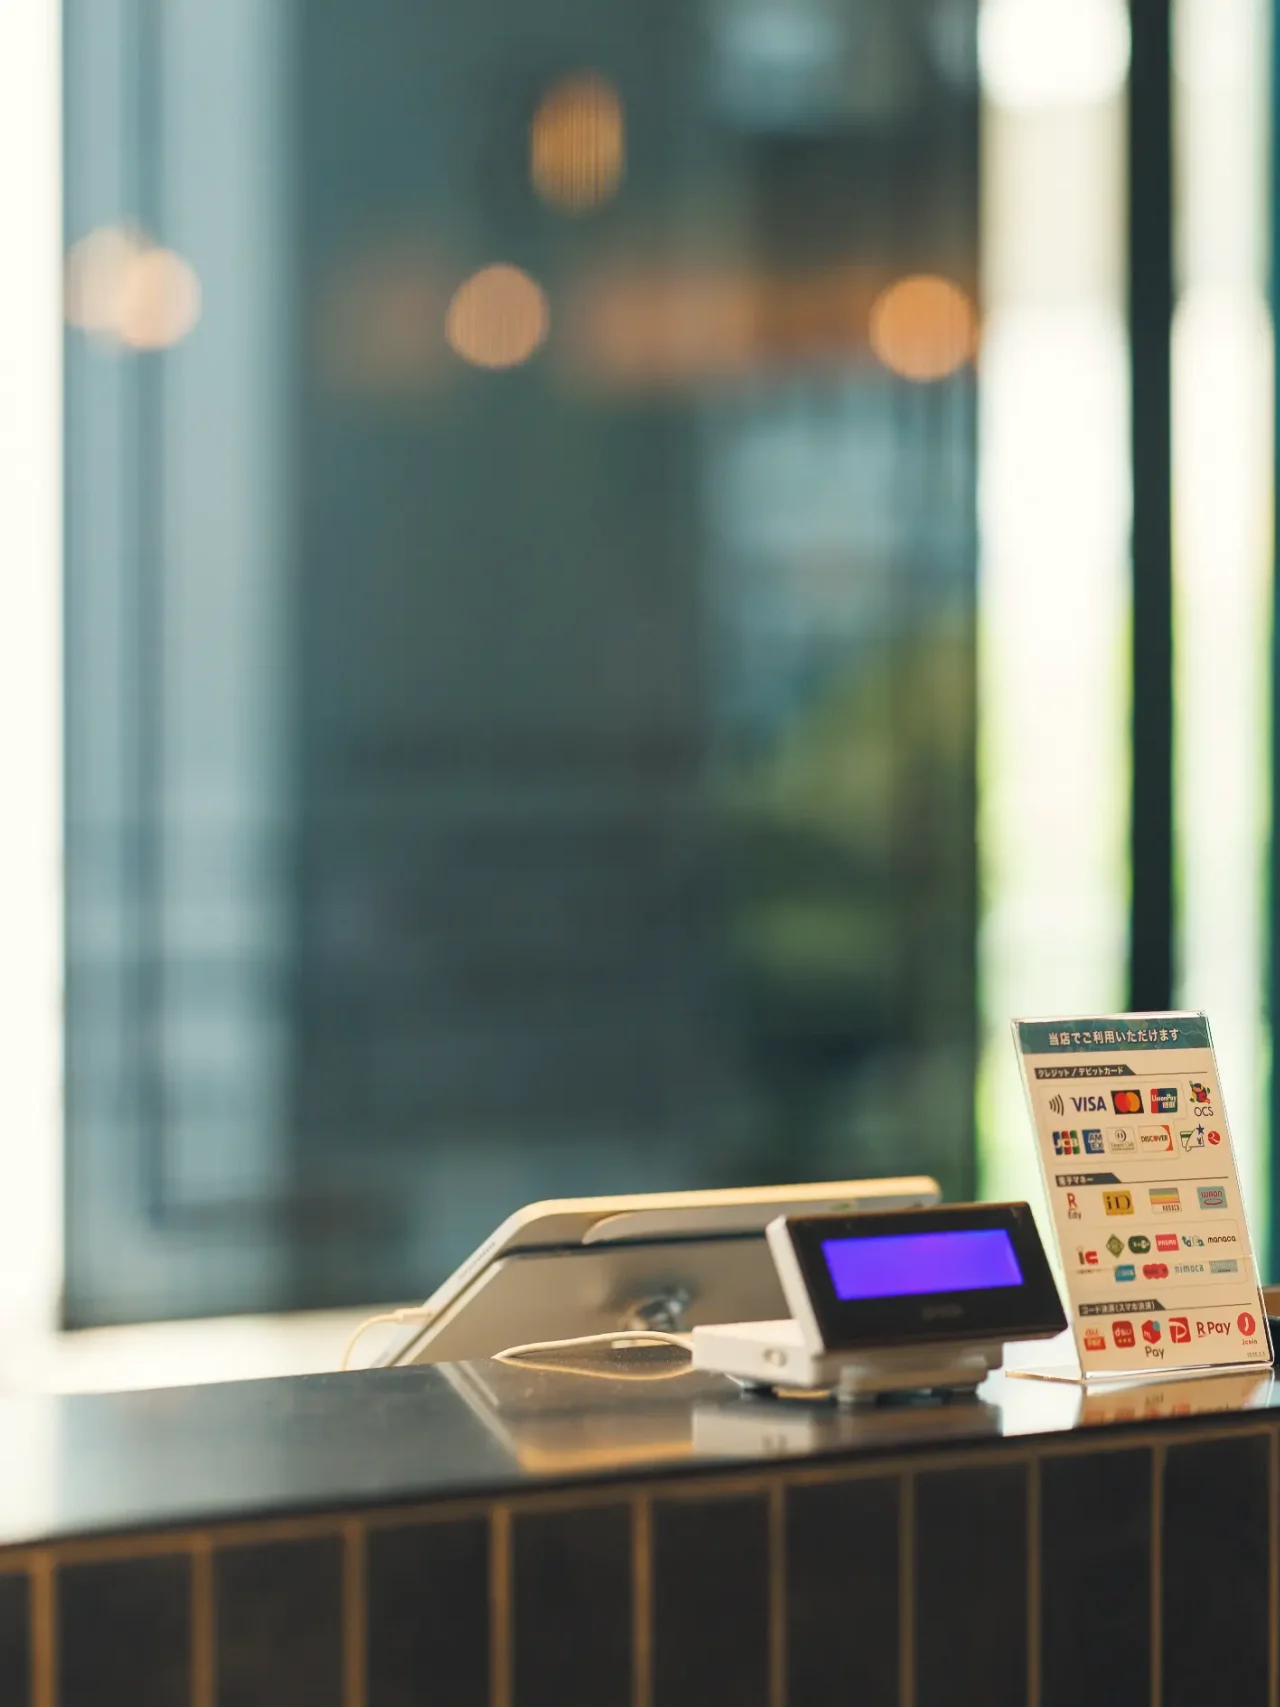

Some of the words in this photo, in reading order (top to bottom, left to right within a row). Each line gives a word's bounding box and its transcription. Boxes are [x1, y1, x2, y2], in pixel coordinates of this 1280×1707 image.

[1049, 1028, 1179, 1046] 当店でご利用いただけます
[1069, 1096, 1107, 1113] VISA
[1151, 1093, 1177, 1105] UnionPay
[1194, 1106, 1214, 1117] OCS
[1140, 1135, 1169, 1143] DISCOVER
[1207, 1235, 1237, 1244] manaca
[1175, 1263, 1204, 1275] nimoca
[1209, 1320, 1231, 1336] Pay
[1144, 1345, 1166, 1359] Pay
